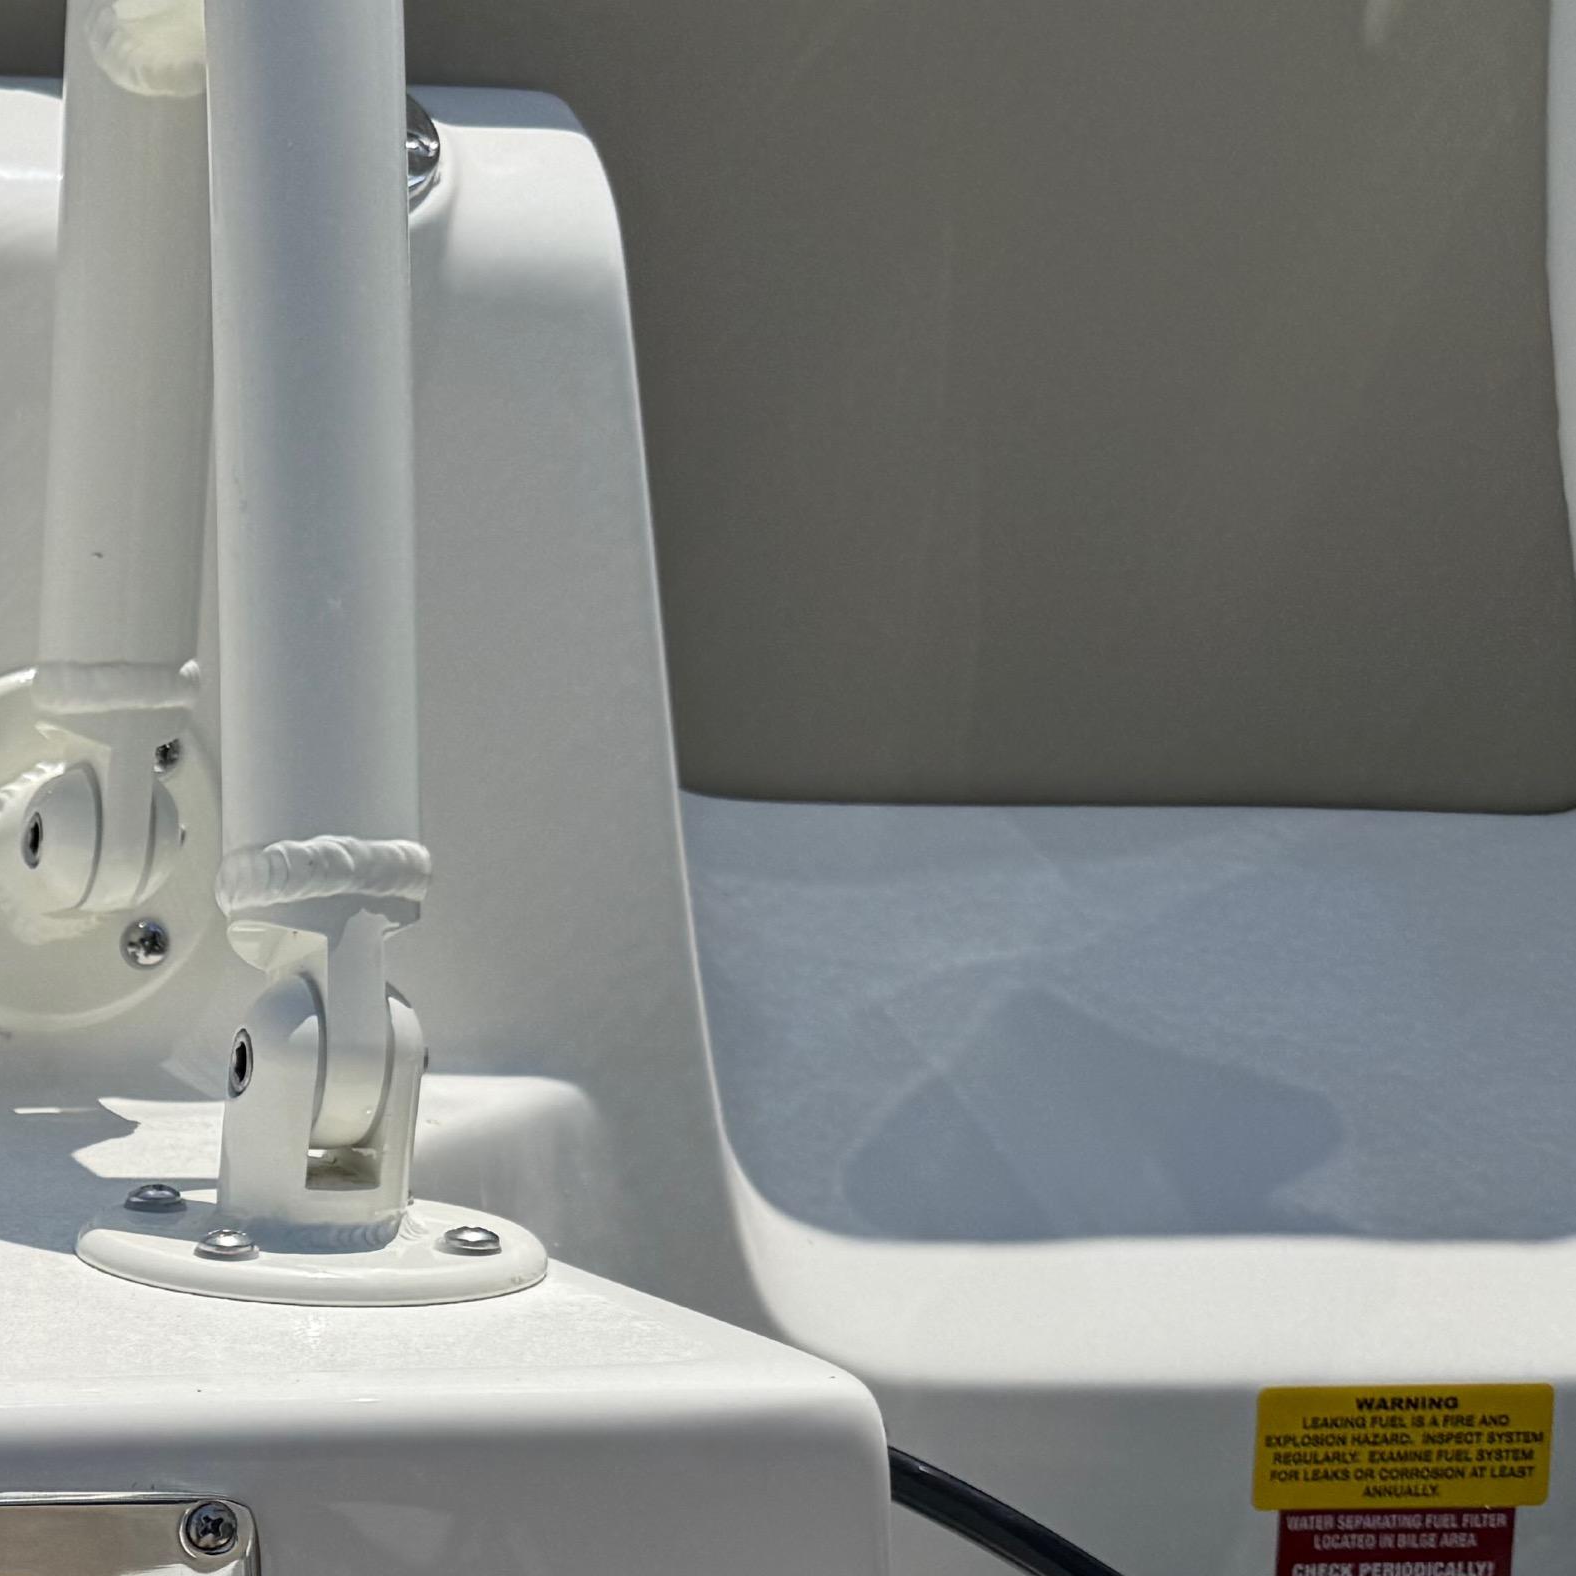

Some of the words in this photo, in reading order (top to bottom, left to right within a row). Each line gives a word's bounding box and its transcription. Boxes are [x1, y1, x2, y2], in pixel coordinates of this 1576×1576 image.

[1356, 1396, 1459, 1411] WARNING
[1303, 1416, 1367, 1430] LEAKING
[1370, 1415, 1406, 1428] FUEL
[1411, 1415, 1428, 1428] IS
[1428, 1415, 1439, 1427] A
[1443, 1414, 1475, 1427] FIRE
[1478, 1414, 1509, 1427] AND
[1265, 1433, 1346, 1448] EXPLOSION
[1422, 1432, 1483, 1445] INSPECT
[1487, 1431, 1544, 1444] SYSTEM
[1368, 1450, 1431, 1463] EXAMINE
[1436, 1449, 1472, 1462] FUEL
[1475, 1448, 1534, 1461] SYSTEM
[1270, 1468, 1299, 1482] FOR
[1303, 1468, 1349, 1481] LEAKS
[1354, 1467, 1374, 1480] OR
[1379, 1467, 1465, 1480] CORROSION
[1469, 1466, 1486, 1478] AT
[1490, 1465, 1535, 1478] LEAST
[1286, 1516, 1333, 1530] WATER
[1336, 1515, 1422, 1529] SEPARATING
[1425, 1514, 1459, 1528] FUEL
[1462, 1513, 1507, 1527] FILTER
[1314, 1534, 1375, 1550] LOCATED
[1379, 1534, 1394, 1548] IN
[1397, 1533, 1437, 1547] BILGE
[1439, 1532, 1477, 1547] AREA
